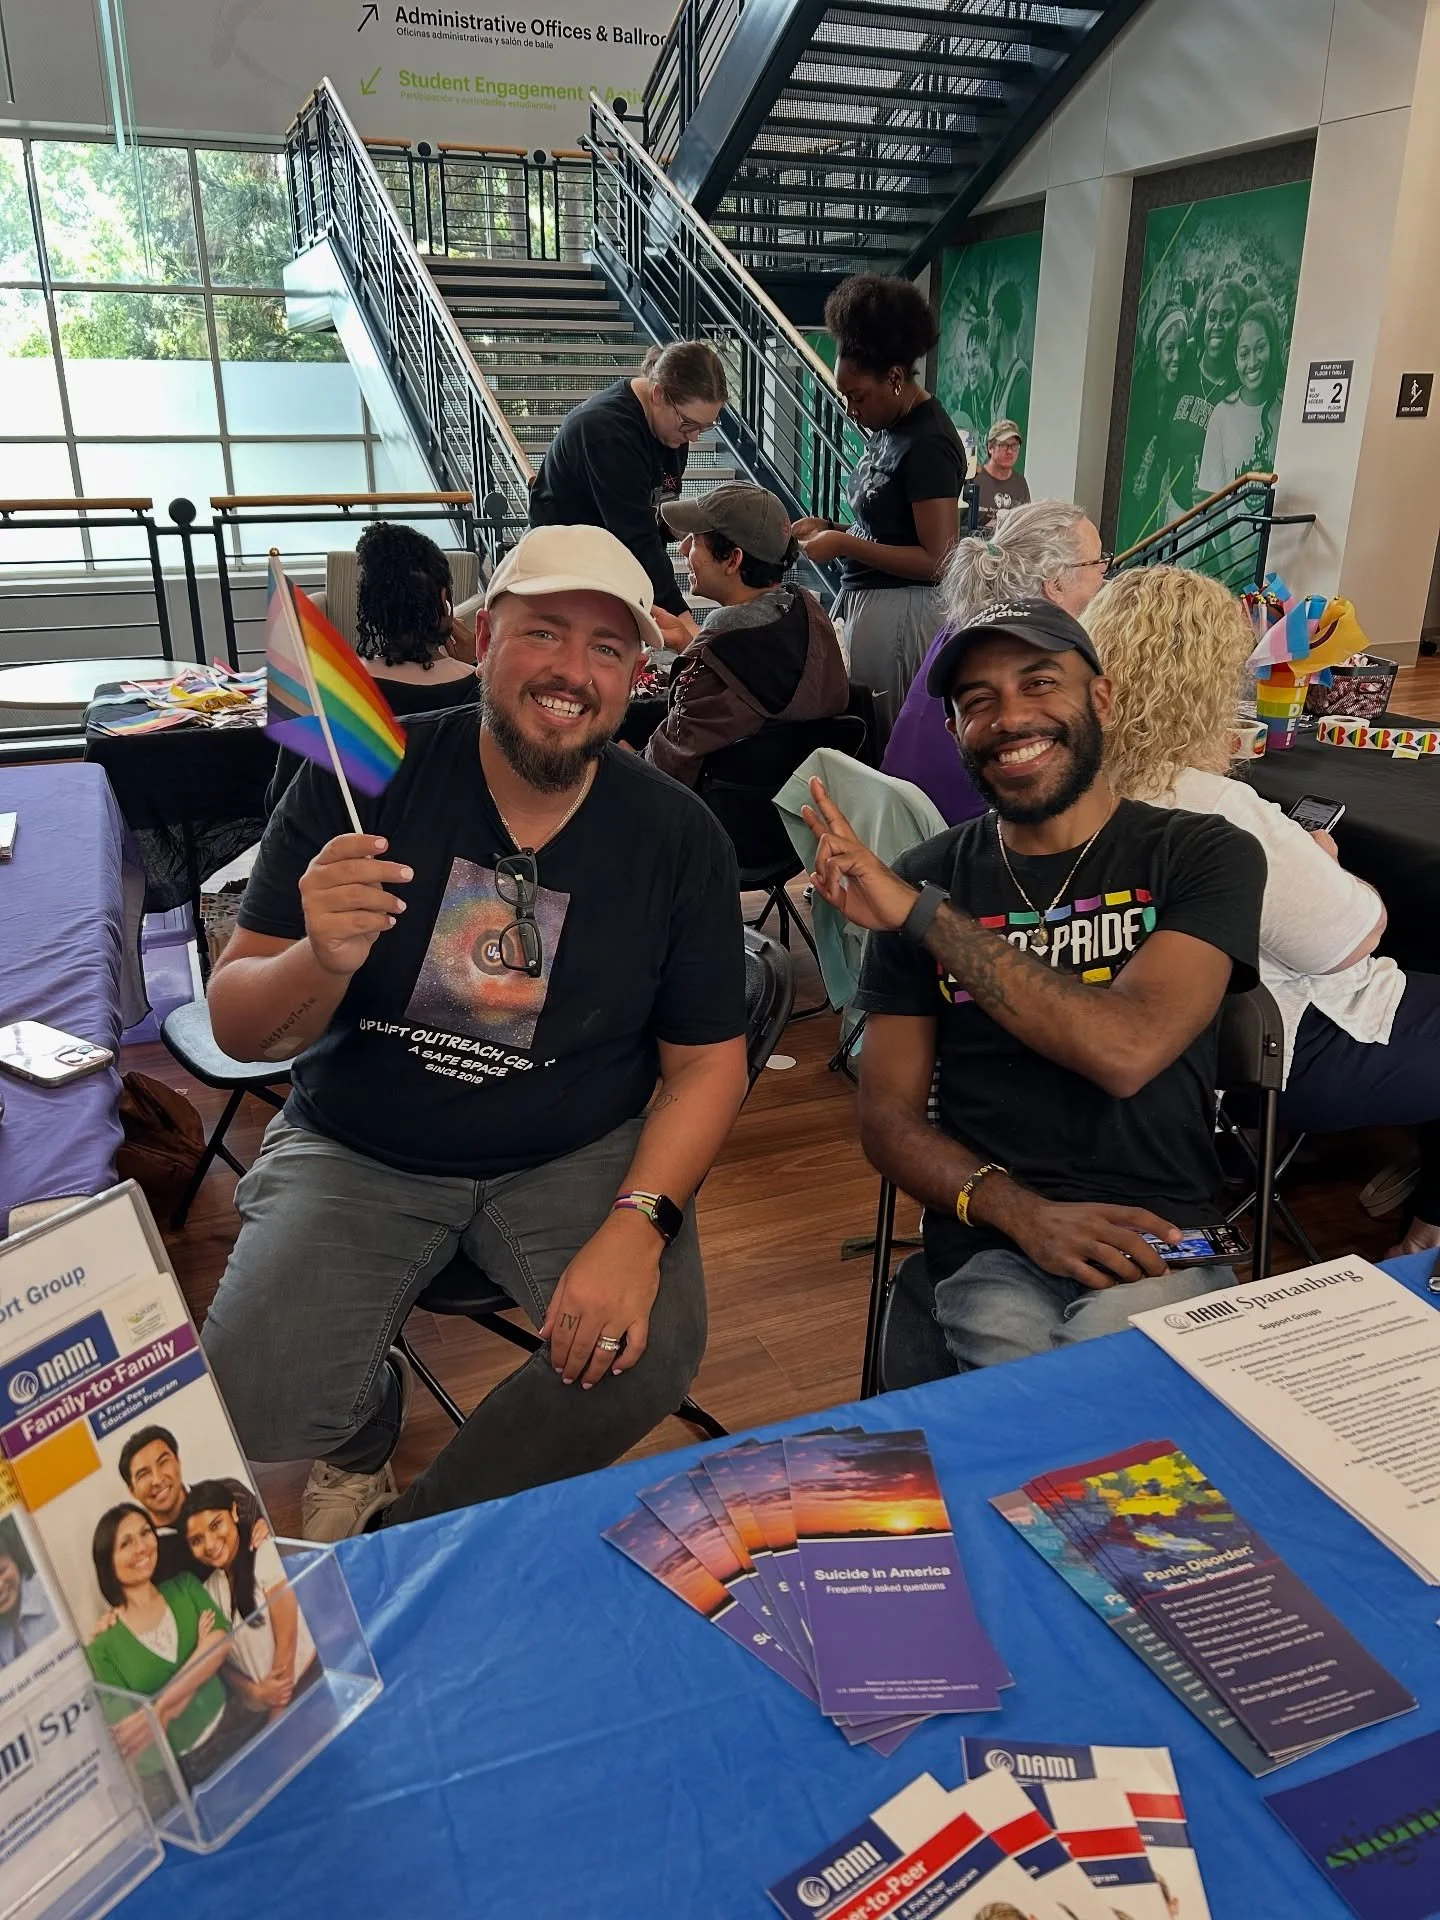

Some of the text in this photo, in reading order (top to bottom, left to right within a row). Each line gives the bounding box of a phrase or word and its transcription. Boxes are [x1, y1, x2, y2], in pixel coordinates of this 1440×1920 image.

[395, 6, 527, 34] Administrative
[531, 19, 592, 41] Offices
[596, 25, 608, 42] &
[396, 27, 431, 39] Oficinas
[432, 31, 493, 44] administrativas
[501, 37, 522, 46] salón
[524, 39, 534, 47] de
[399, 70, 471, 92] Student
[475, 76, 584, 101] Engagement
[1331, 382, 1343, 404] 2
[1050, 907, 1144, 968] PRIDE
[359, 1018, 411, 1039] UPLIFT
[410, 1028, 504, 1062] OUTREACH
[408, 1045, 509, 1078] A SAFE SPACE
[424, 1062, 484, 1085] SINCE 2019
[26, 1266, 86, 1305] Group
[1185, 1270, 1365, 1324] NAMI Spartanburg
[1258, 1316, 1292, 1330] Support
[1292, 1308, 1323, 1322] Groups
[37, 1337, 99, 1389] NAMI
[20, 1339, 175, 1442] Family-to-Family
[98, 1387, 147, 1420] A Free Peer
[101, 1379, 179, 1430] Education Program
[814, 1566, 951, 1581] Suicide in America
[1143, 1545, 1254, 1583] Panic Disorder:
[826, 1582, 946, 1595] Frequently asked questions
[1016, 1753, 1077, 1779] NAMI
[820, 1840, 883, 1892] NAMI
[842, 1860, 929, 1920] er-to-Peer
